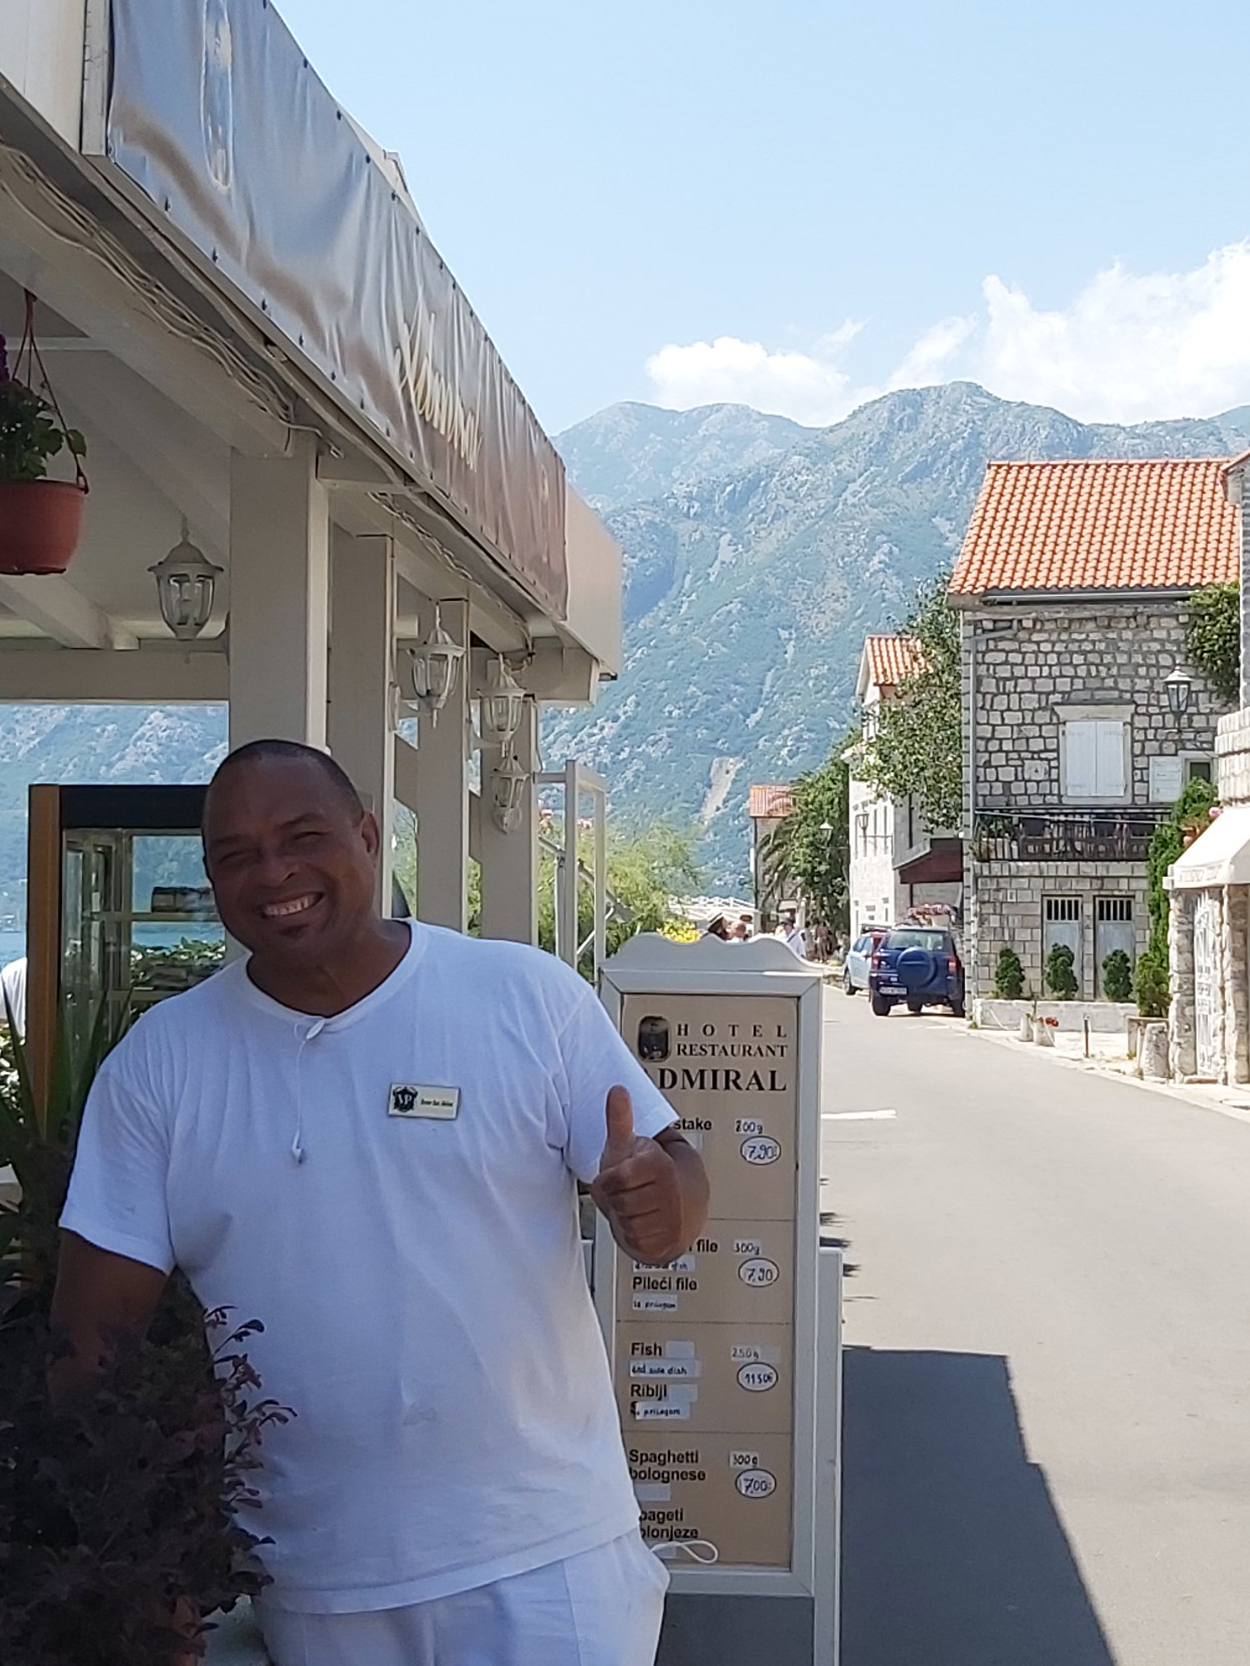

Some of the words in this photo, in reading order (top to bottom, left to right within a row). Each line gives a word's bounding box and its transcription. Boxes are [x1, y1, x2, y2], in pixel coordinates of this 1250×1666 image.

[677, 1043, 788, 1058] RESTAURANT
[644, 1067, 787, 1091] DMIRAL
[696, 1239, 718, 1253] file
[676, 1277, 698, 1291] file
[631, 1342, 663, 1357] Fish
[630, 1383, 668, 1401] Riblji
[629, 1449, 699, 1466] Spaghetti
[629, 1466, 706, 1484] bolognese
[639, 1507, 684, 1524] pageti
[640, 1525, 699, 1542] olonjeze
